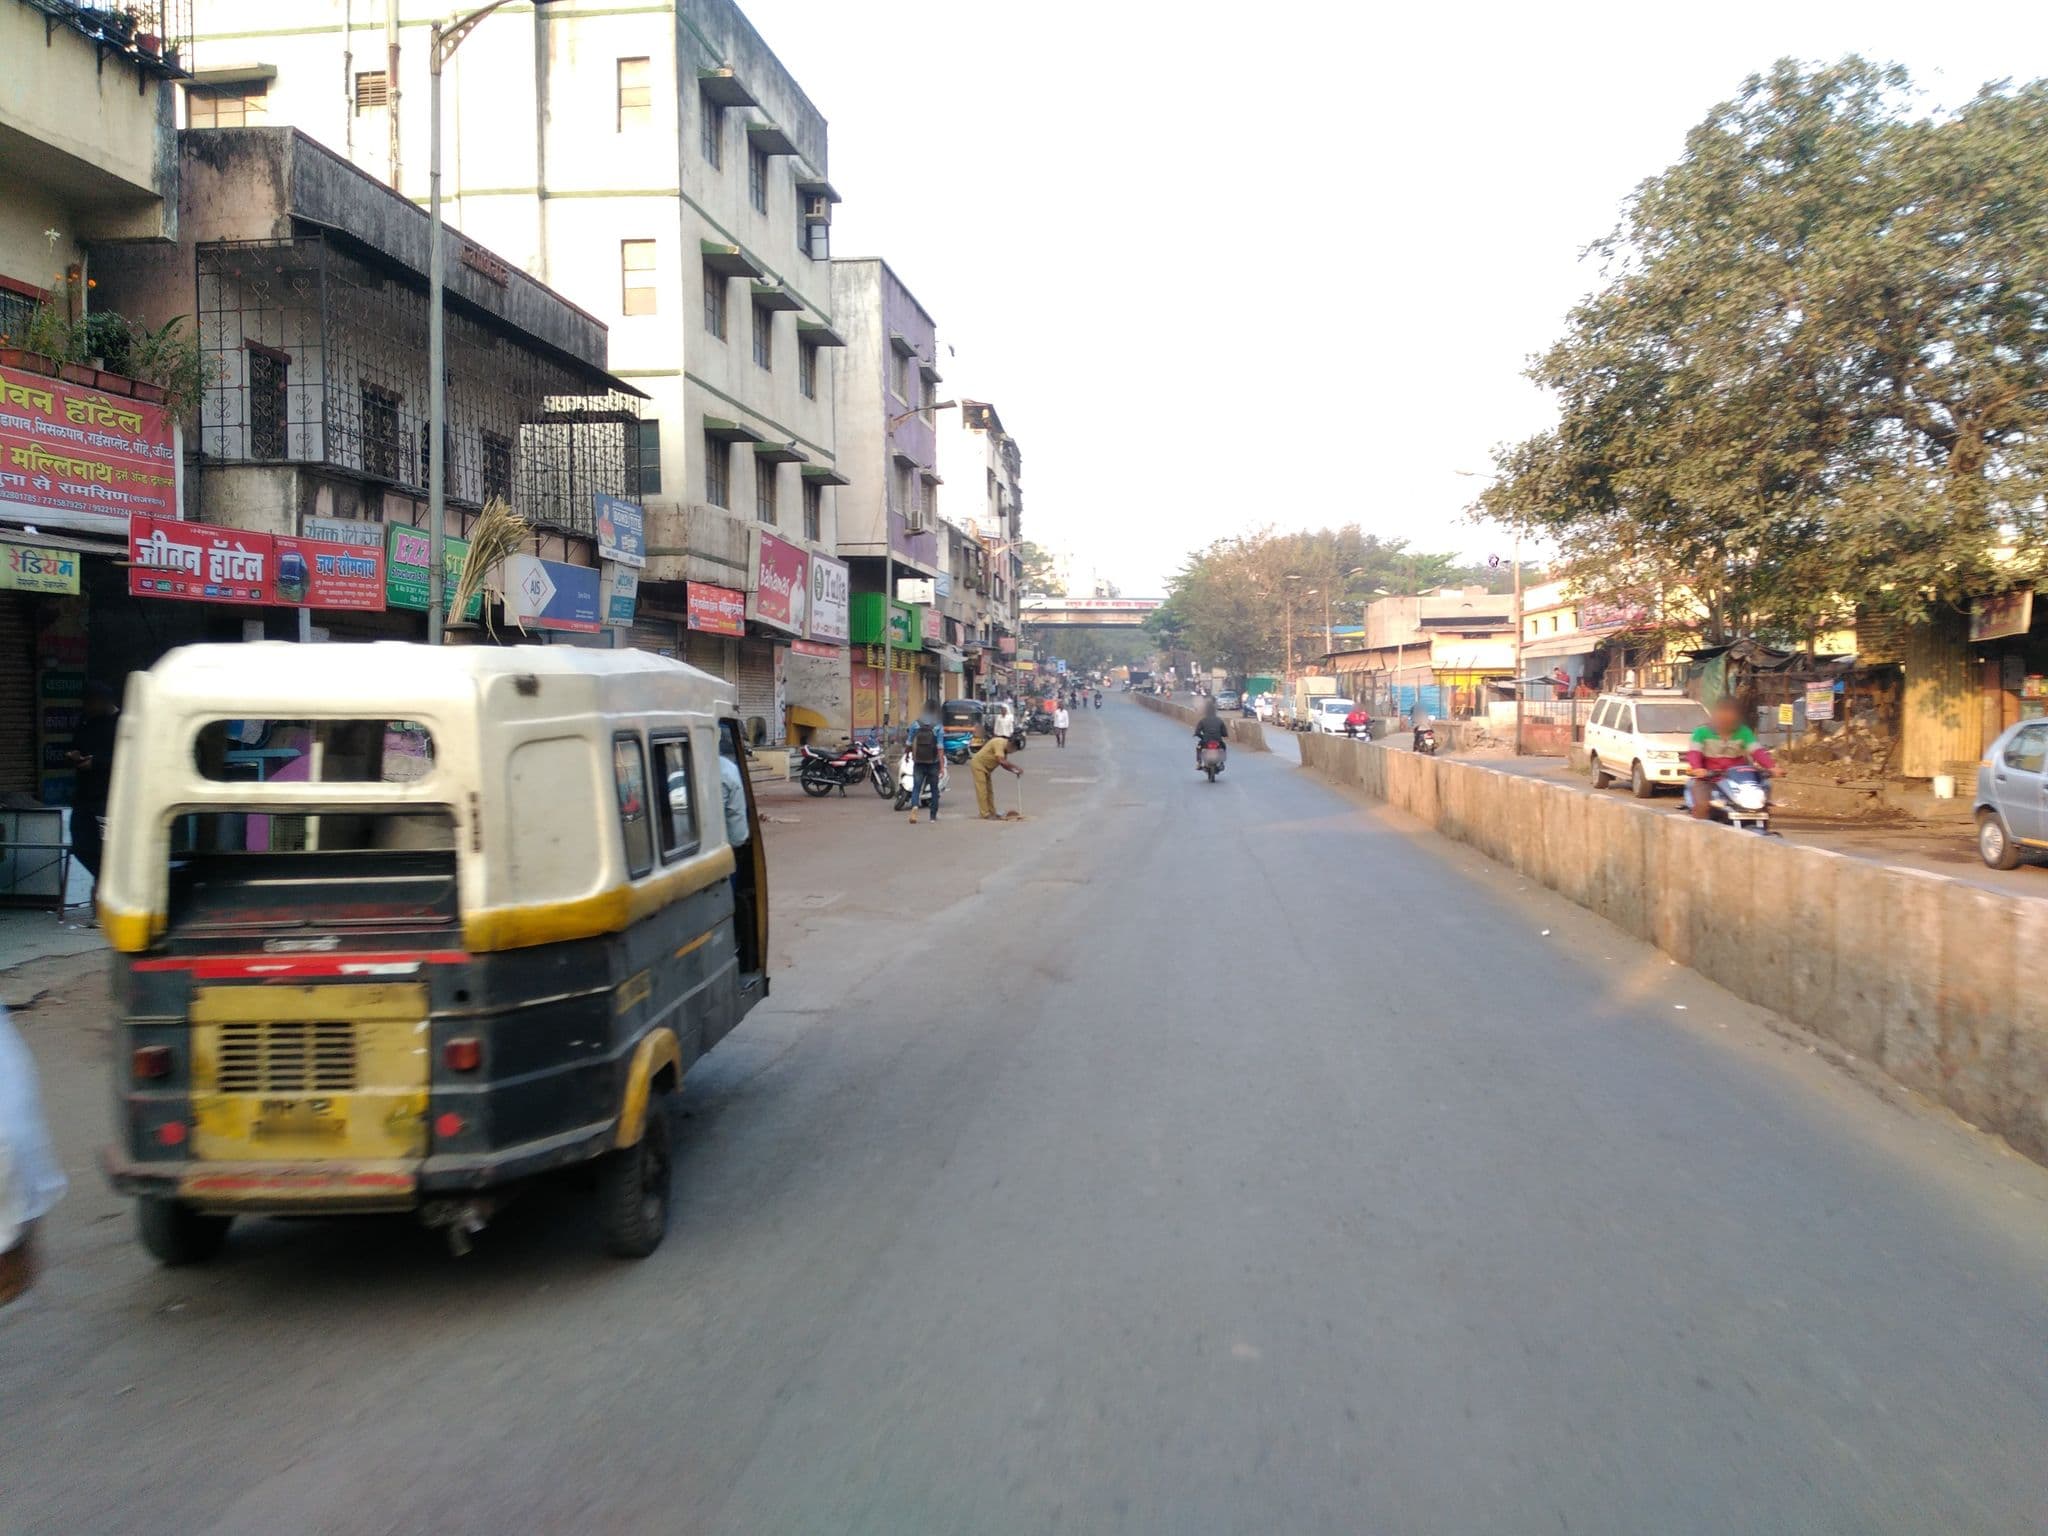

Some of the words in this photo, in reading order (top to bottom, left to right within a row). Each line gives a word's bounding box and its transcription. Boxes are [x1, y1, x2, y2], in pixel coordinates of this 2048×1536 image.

[64, 394, 143, 435] हॉटेल
[32, 475, 52, 491] से
[8, 547, 74, 577] रेडियम
[207, 538, 264, 583] हॉटेल
[315, 554, 335, 577] जय
[336, 549, 376, 579] सोमनाथ
[530, 580, 540, 595] AIS
